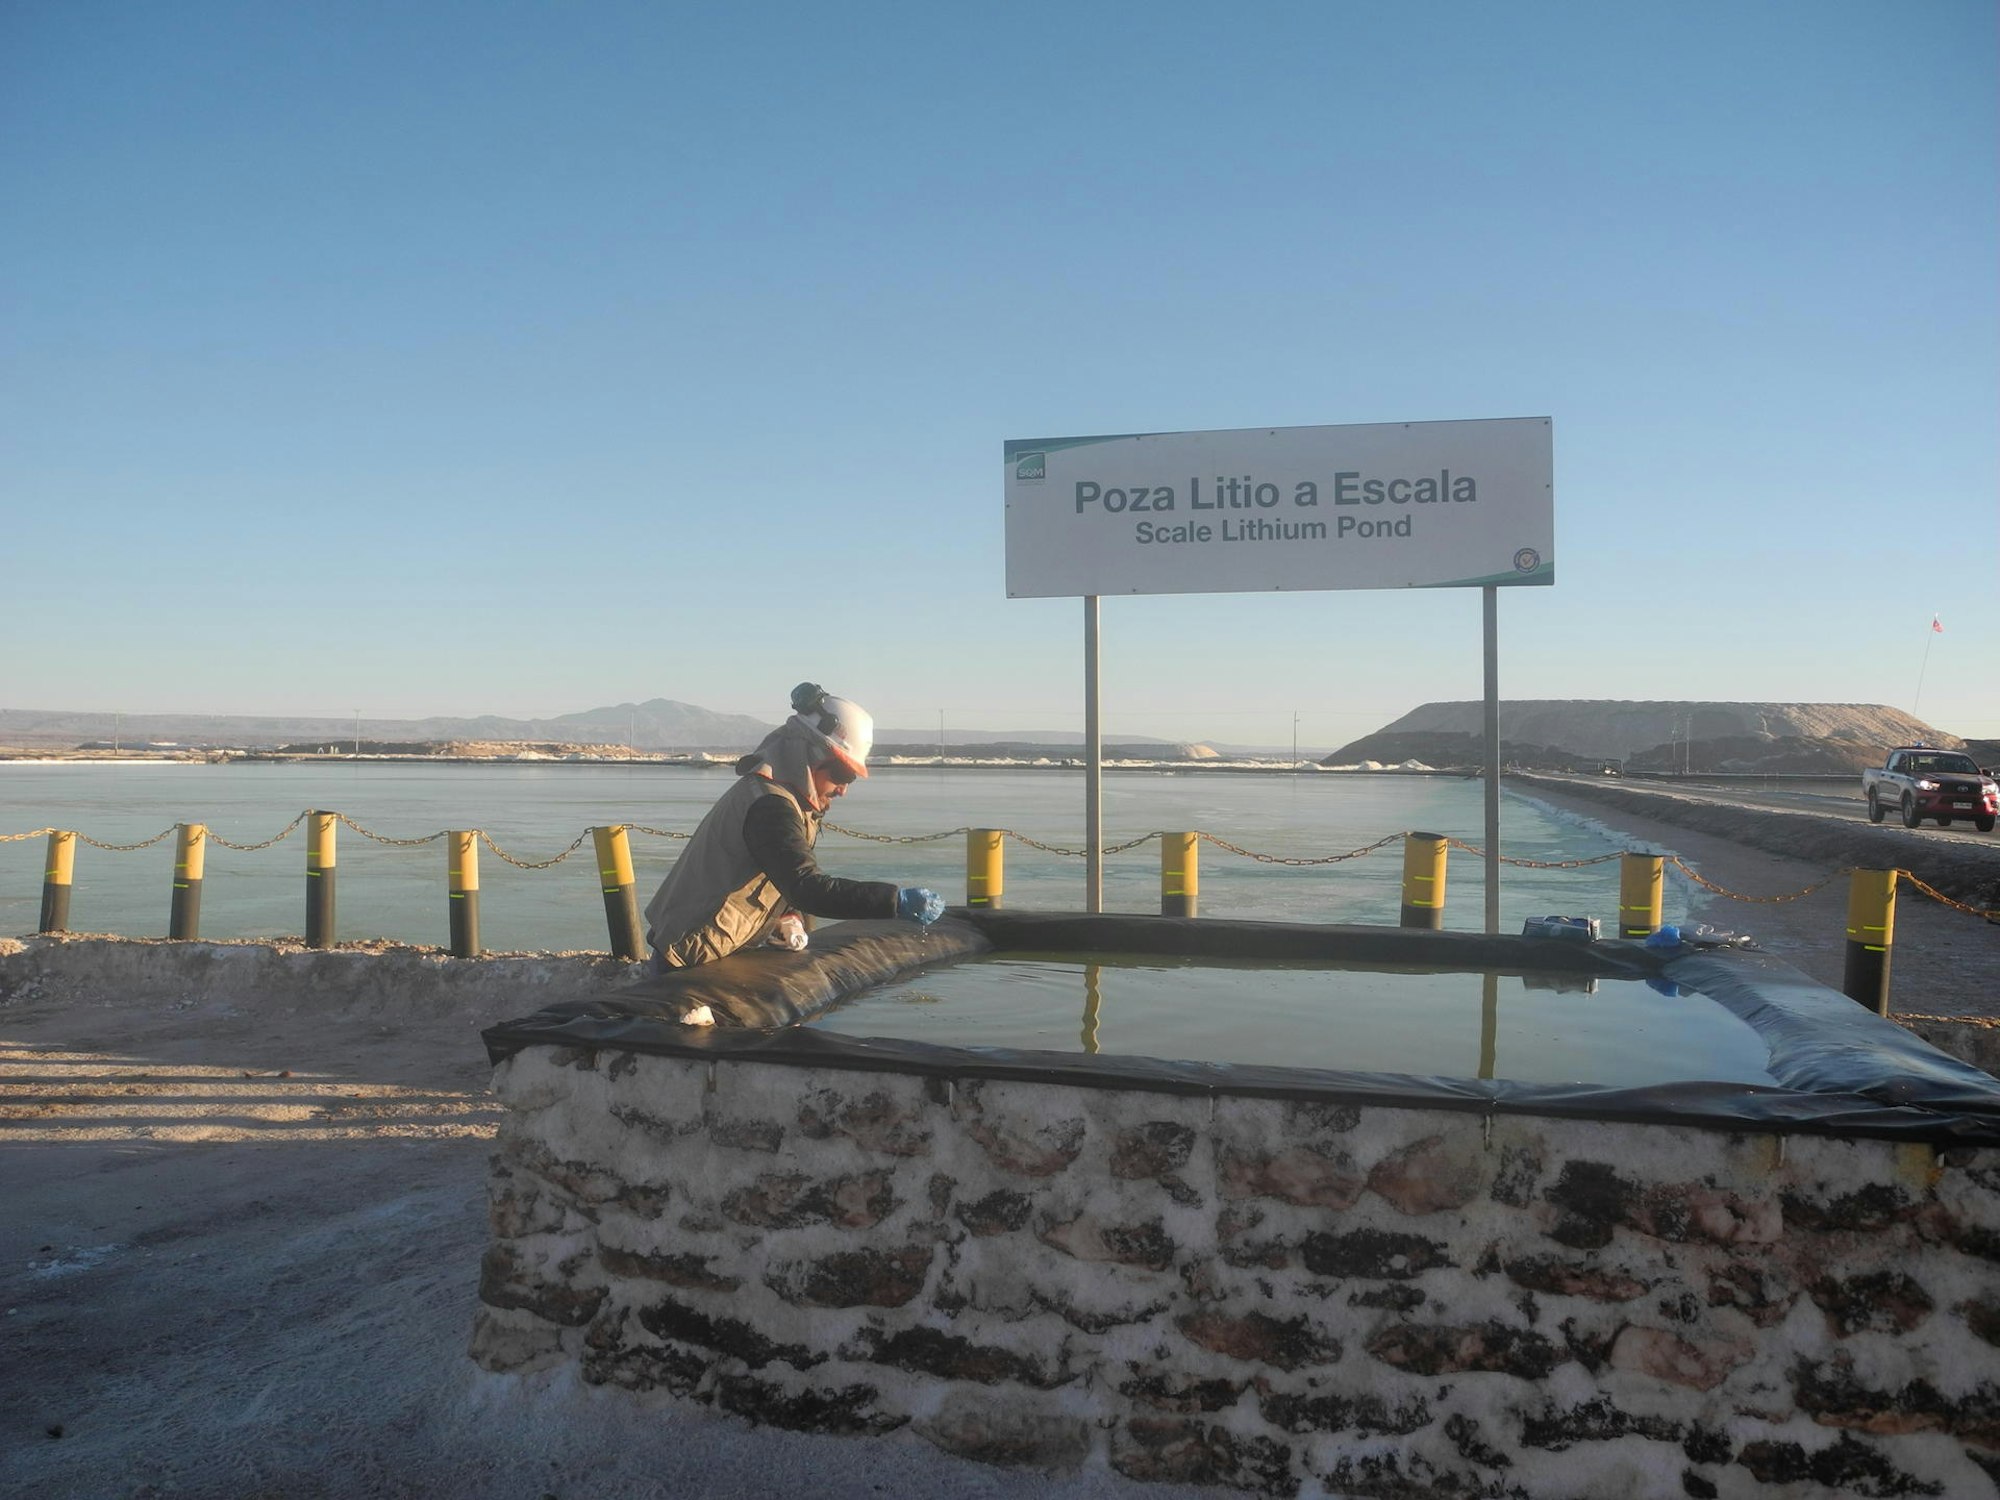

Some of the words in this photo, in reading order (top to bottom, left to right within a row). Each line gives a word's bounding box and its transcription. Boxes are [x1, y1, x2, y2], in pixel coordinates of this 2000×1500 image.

[1018, 468, 1043, 477] SQM
[1075, 481, 1175, 514] Poza
[1190, 475, 1280, 510] Litio
[1294, 481, 1318, 508] a
[1334, 468, 1477, 506] Escala
[1135, 519, 1213, 545] Scale
[1222, 517, 1327, 542] Lithium
[1337, 513, 1412, 539] Pond
